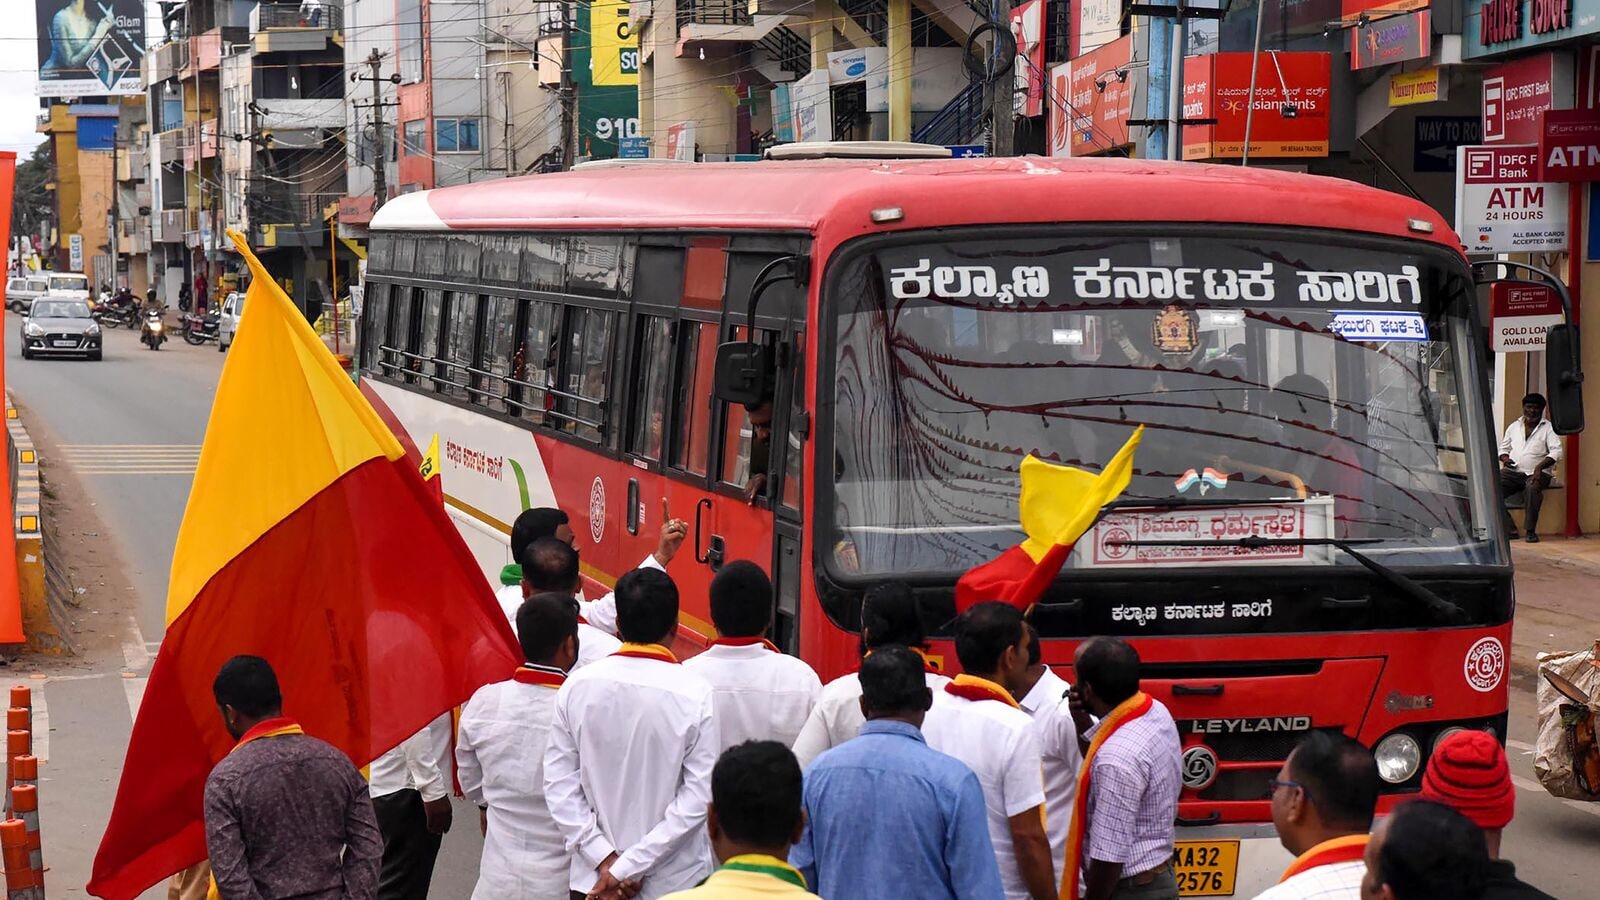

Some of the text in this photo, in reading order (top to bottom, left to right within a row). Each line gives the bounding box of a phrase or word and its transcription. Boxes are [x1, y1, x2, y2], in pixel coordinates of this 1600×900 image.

[116, 15, 141, 28] Glam
[1481, 0, 1518, 46] DELUXE
[1416, 80, 1437, 96] rooms
[1506, 81, 1550, 101] IDFC FIRST Bank
[1418, 120, 1442, 141] WAY
[1446, 121, 1459, 141] TO
[1499, 155, 1526, 166] IDFC
[1547, 145, 1600, 168] ATM
[1499, 168, 1528, 178] Bank
[1487, 187, 1544, 209] ATM
[1486, 211, 1544, 221] 24 HOURS
[890, 258, 1421, 304] ಕಲ್ಯಾಣ ಕರ್ನಾಟಕ ಸಾರಿಗೆ
[1502, 326, 1549, 336] GOLD LOA
[1503, 337, 1547, 346] AVAILABL
[1111, 598, 1272, 626] ಕಲ್ಯಾಣ ಕರ್ನಾಟಕ ಸಾರಿಗೆ
[1191, 716, 1311, 733] LEYLAND
[1176, 871, 1223, 891] 2576
